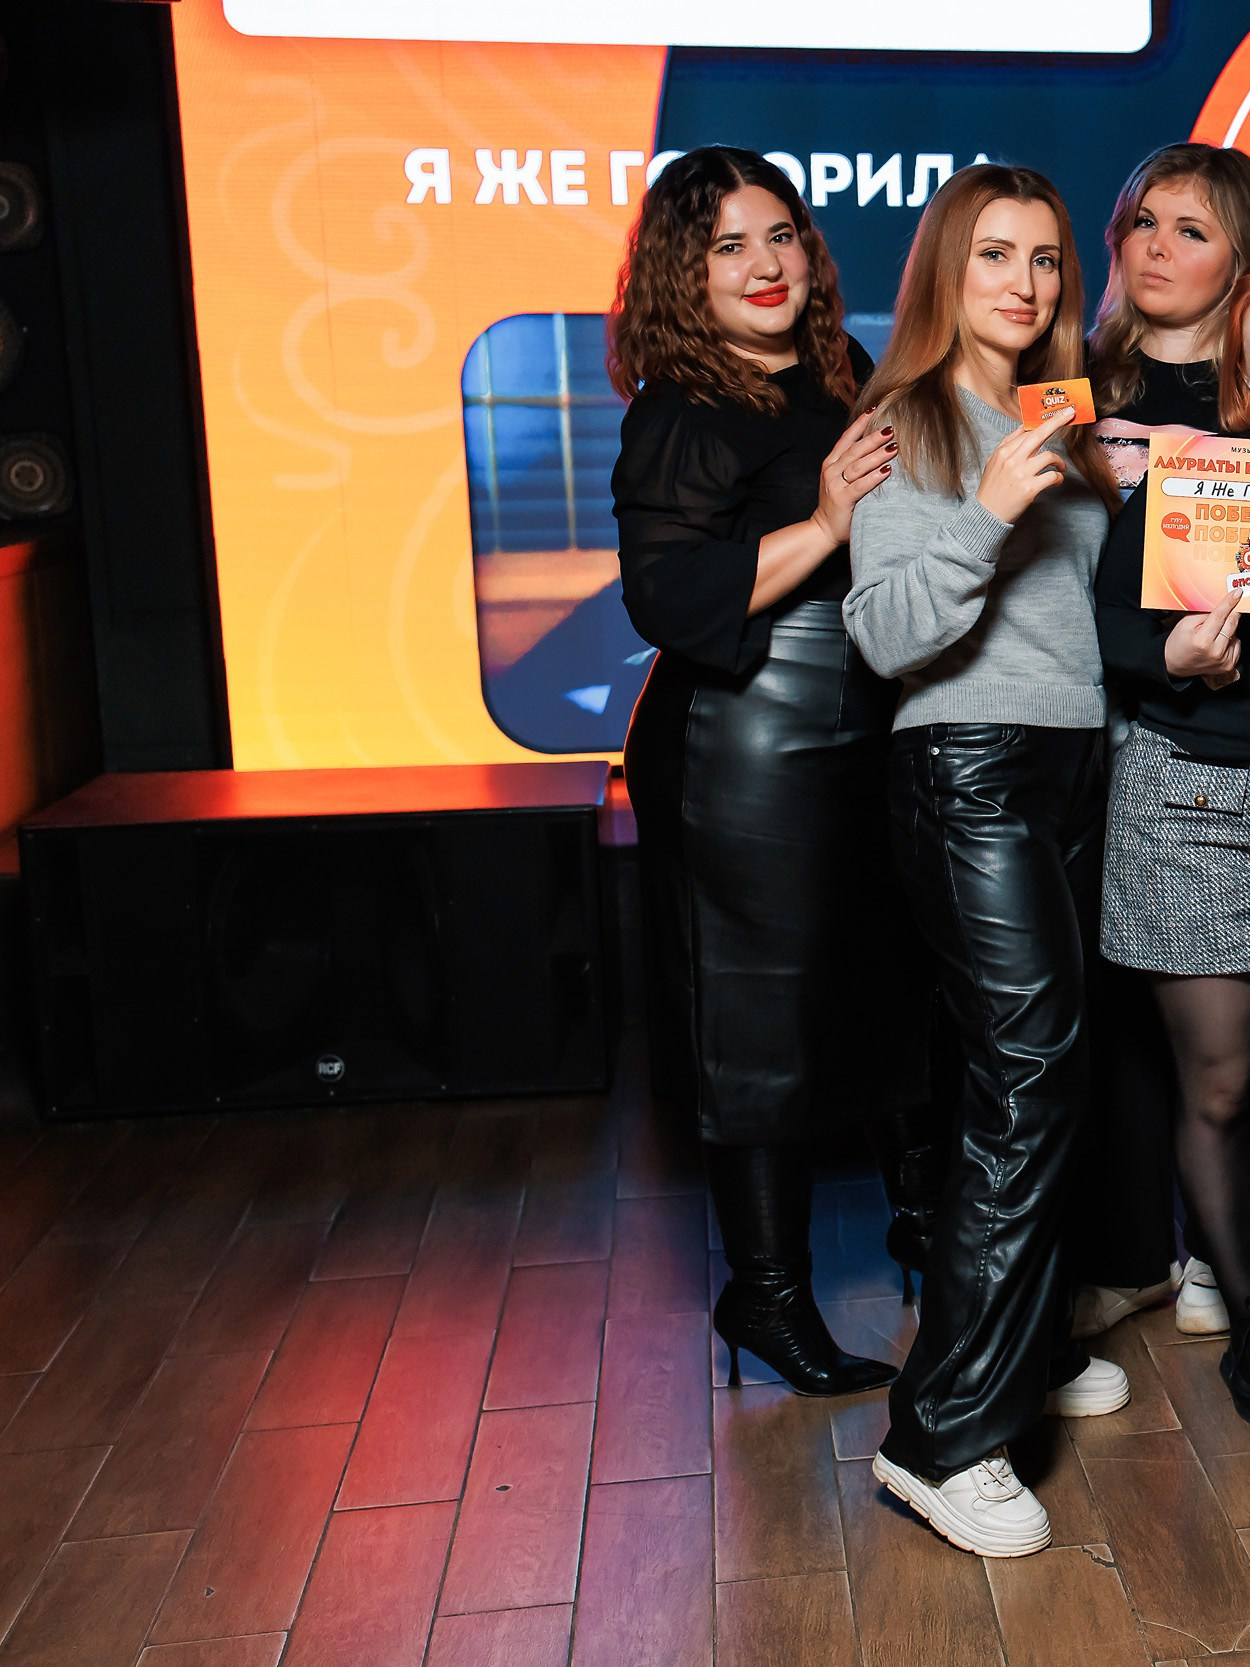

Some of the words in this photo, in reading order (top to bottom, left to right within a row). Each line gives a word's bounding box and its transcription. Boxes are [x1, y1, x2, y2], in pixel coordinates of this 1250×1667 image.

[404, 148, 452, 204] Я
[474, 148, 588, 206] ЖЕ
[1045, 395, 1066, 405] QUIZ
[1153, 455, 1241, 474] ЛАУРЕАТЫ
[1194, 481, 1205, 495] Я
